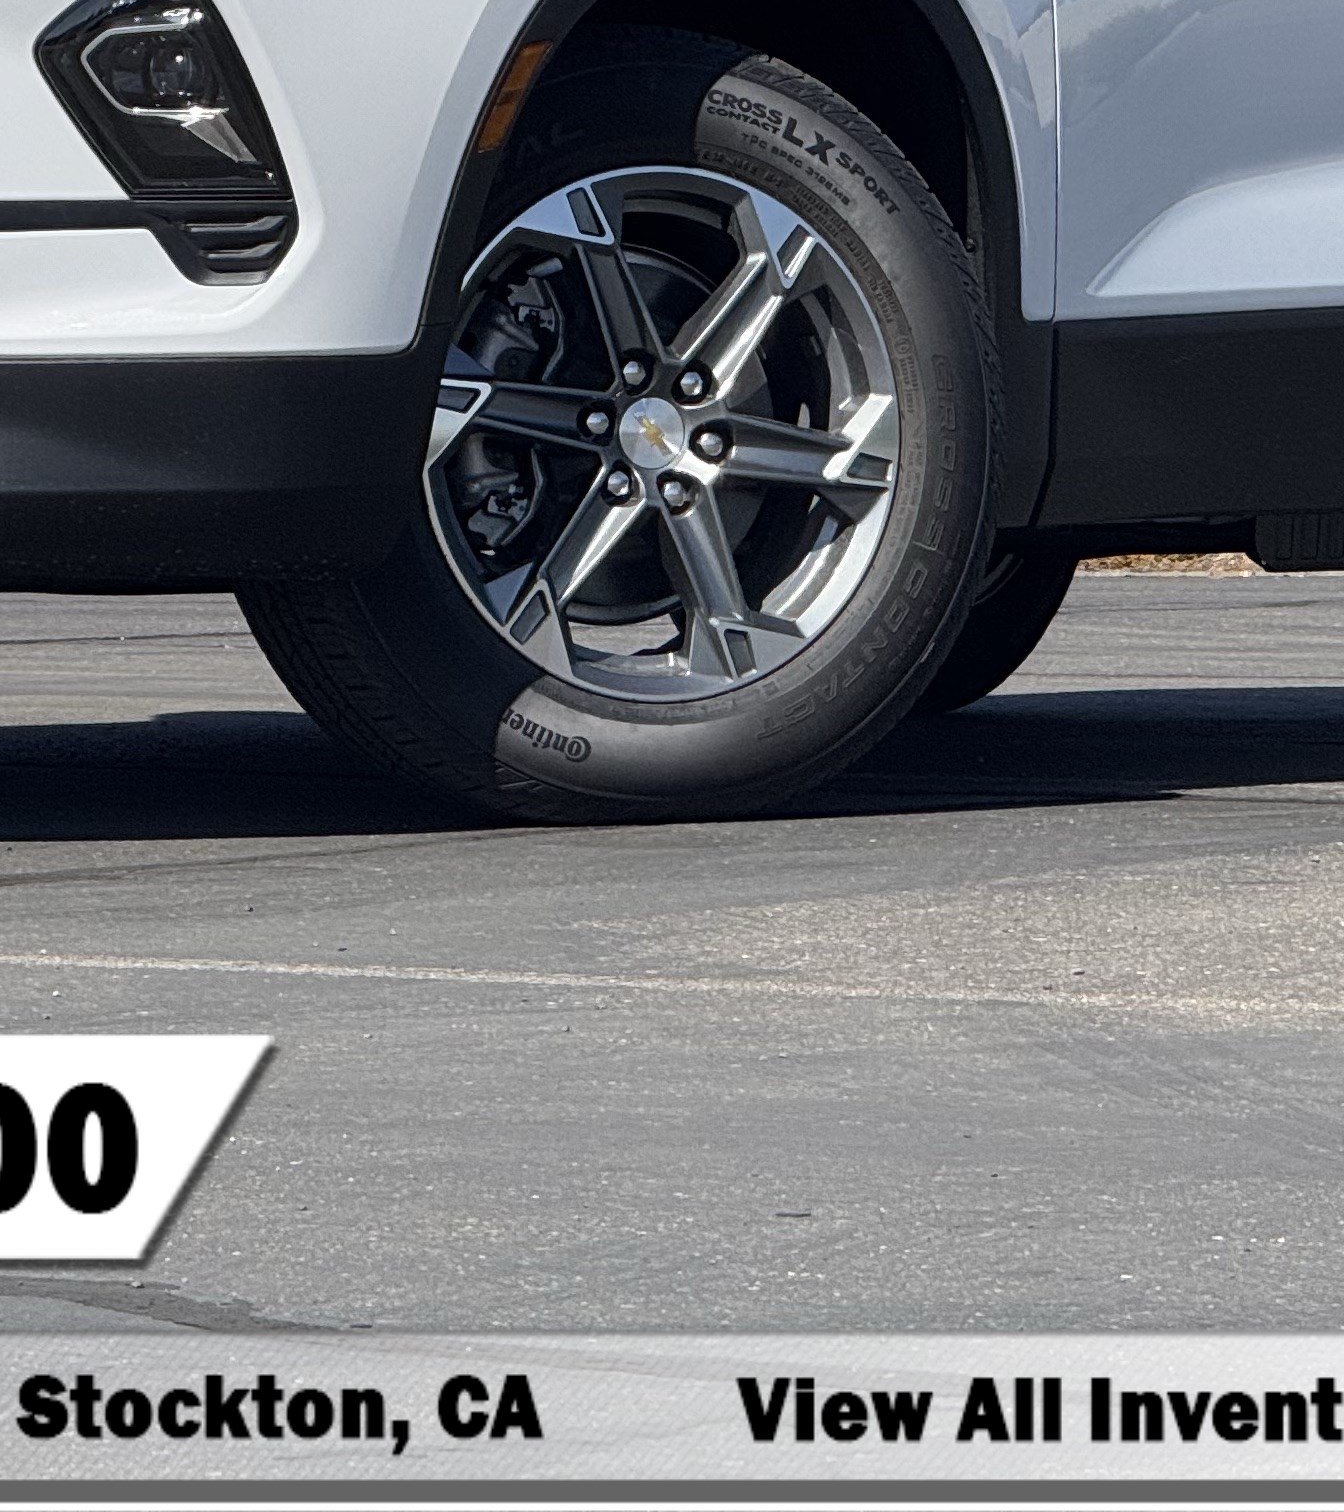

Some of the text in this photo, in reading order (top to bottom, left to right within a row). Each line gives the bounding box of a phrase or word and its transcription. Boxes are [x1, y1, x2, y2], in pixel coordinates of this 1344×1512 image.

[707, 105, 781, 135] CONTACT
[707, 89, 783, 125] CROSS
[836, 151, 901, 215] SPORT
